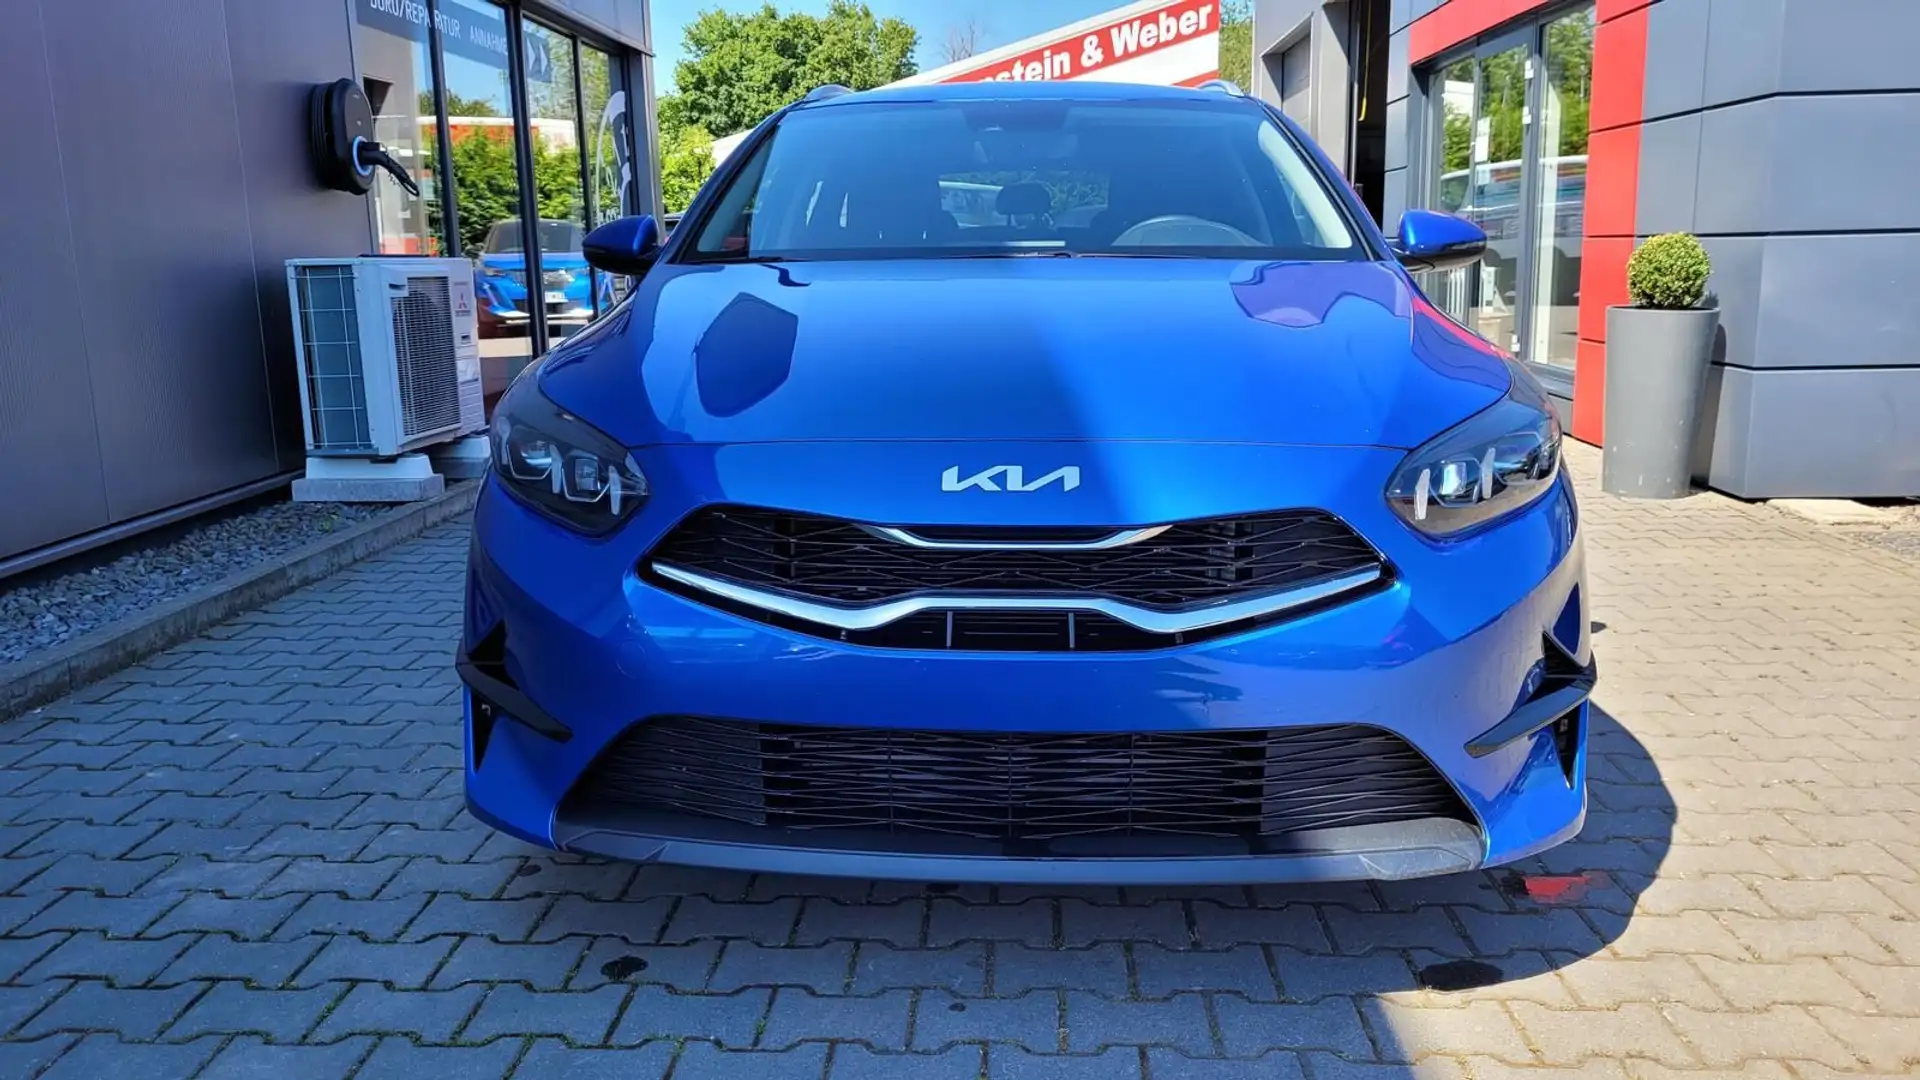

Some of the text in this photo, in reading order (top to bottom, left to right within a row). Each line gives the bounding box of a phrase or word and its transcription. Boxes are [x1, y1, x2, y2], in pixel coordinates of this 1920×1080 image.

[983, 4, 1213, 82] tein & Weber
[941, 465, 1080, 492] KIA
